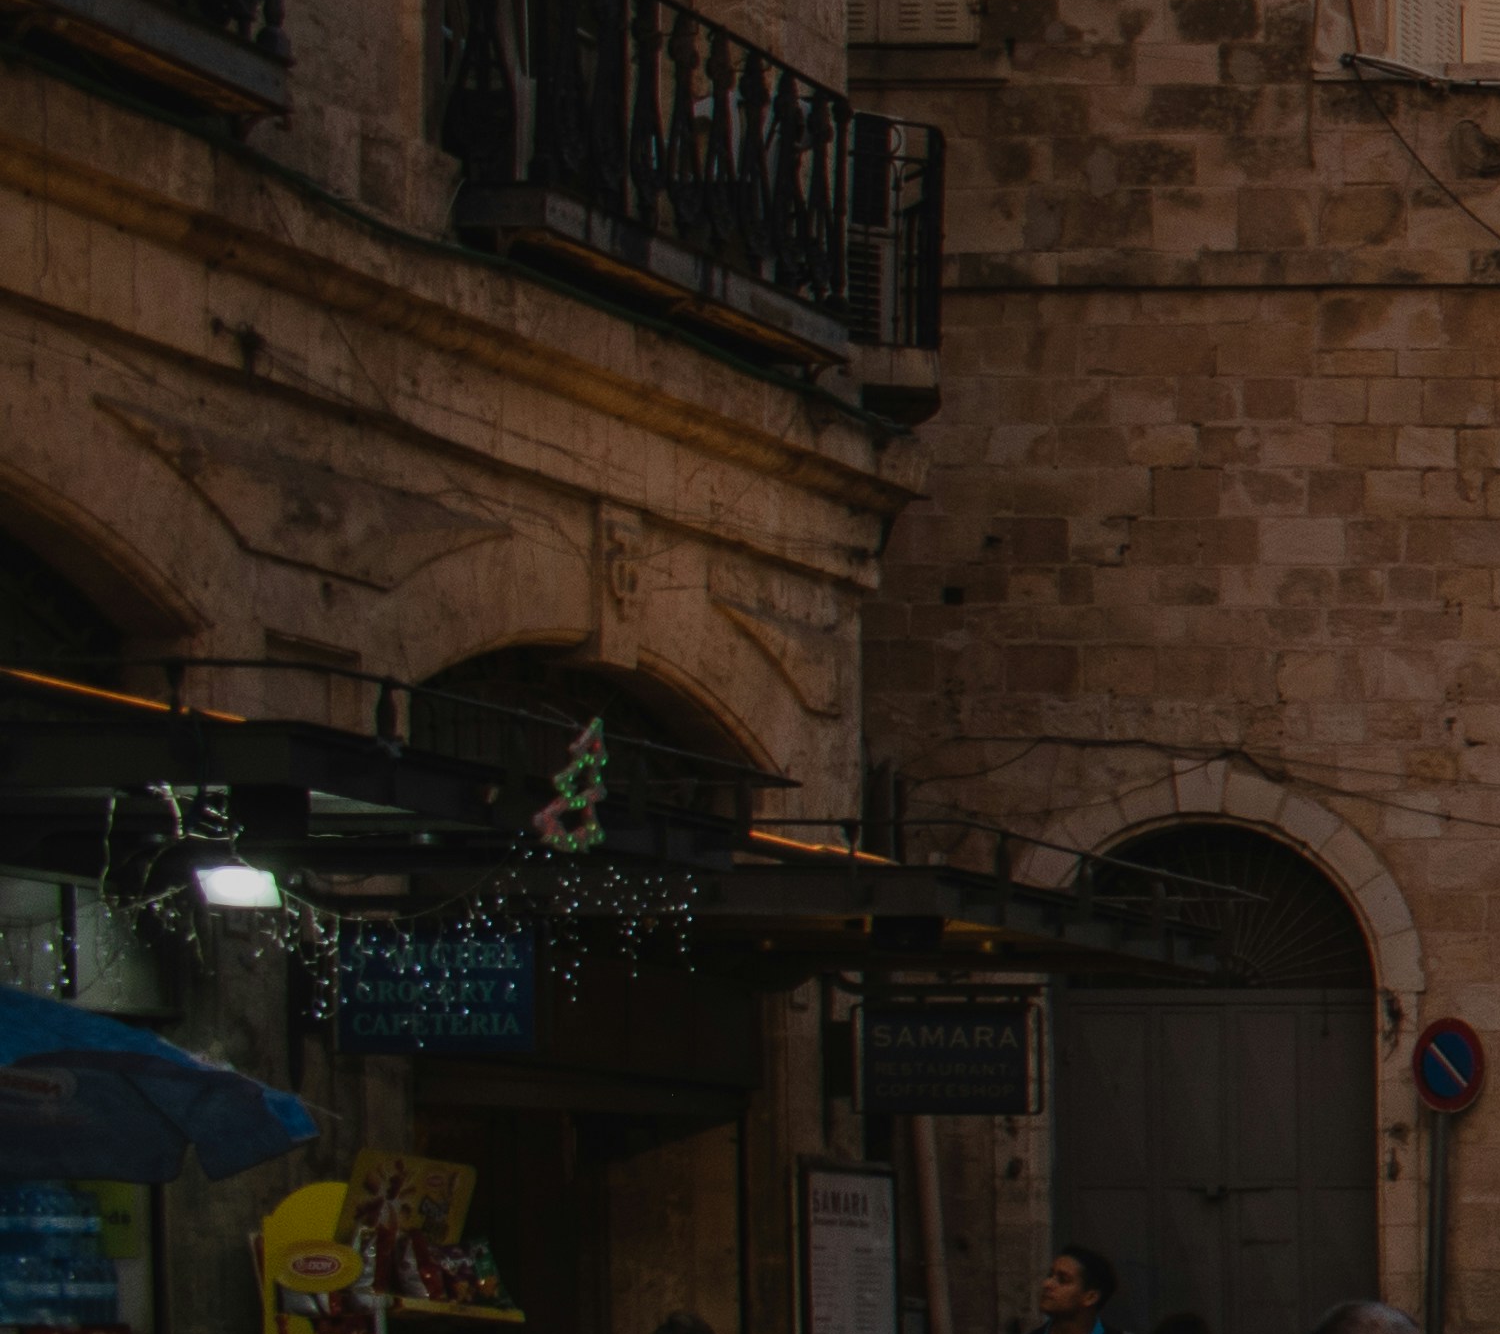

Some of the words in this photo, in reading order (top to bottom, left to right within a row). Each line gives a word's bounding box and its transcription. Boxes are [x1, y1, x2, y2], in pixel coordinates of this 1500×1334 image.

[387, 942, 524, 969] MICHEL
[355, 980, 498, 1003] GROCERY
[352, 1012, 522, 1036] CAFETERIA
[871, 1024, 1018, 1049] SAMARA
[874, 1061, 1009, 1077] RESTAURANT
[813, 1188, 869, 1217] SAMARA
